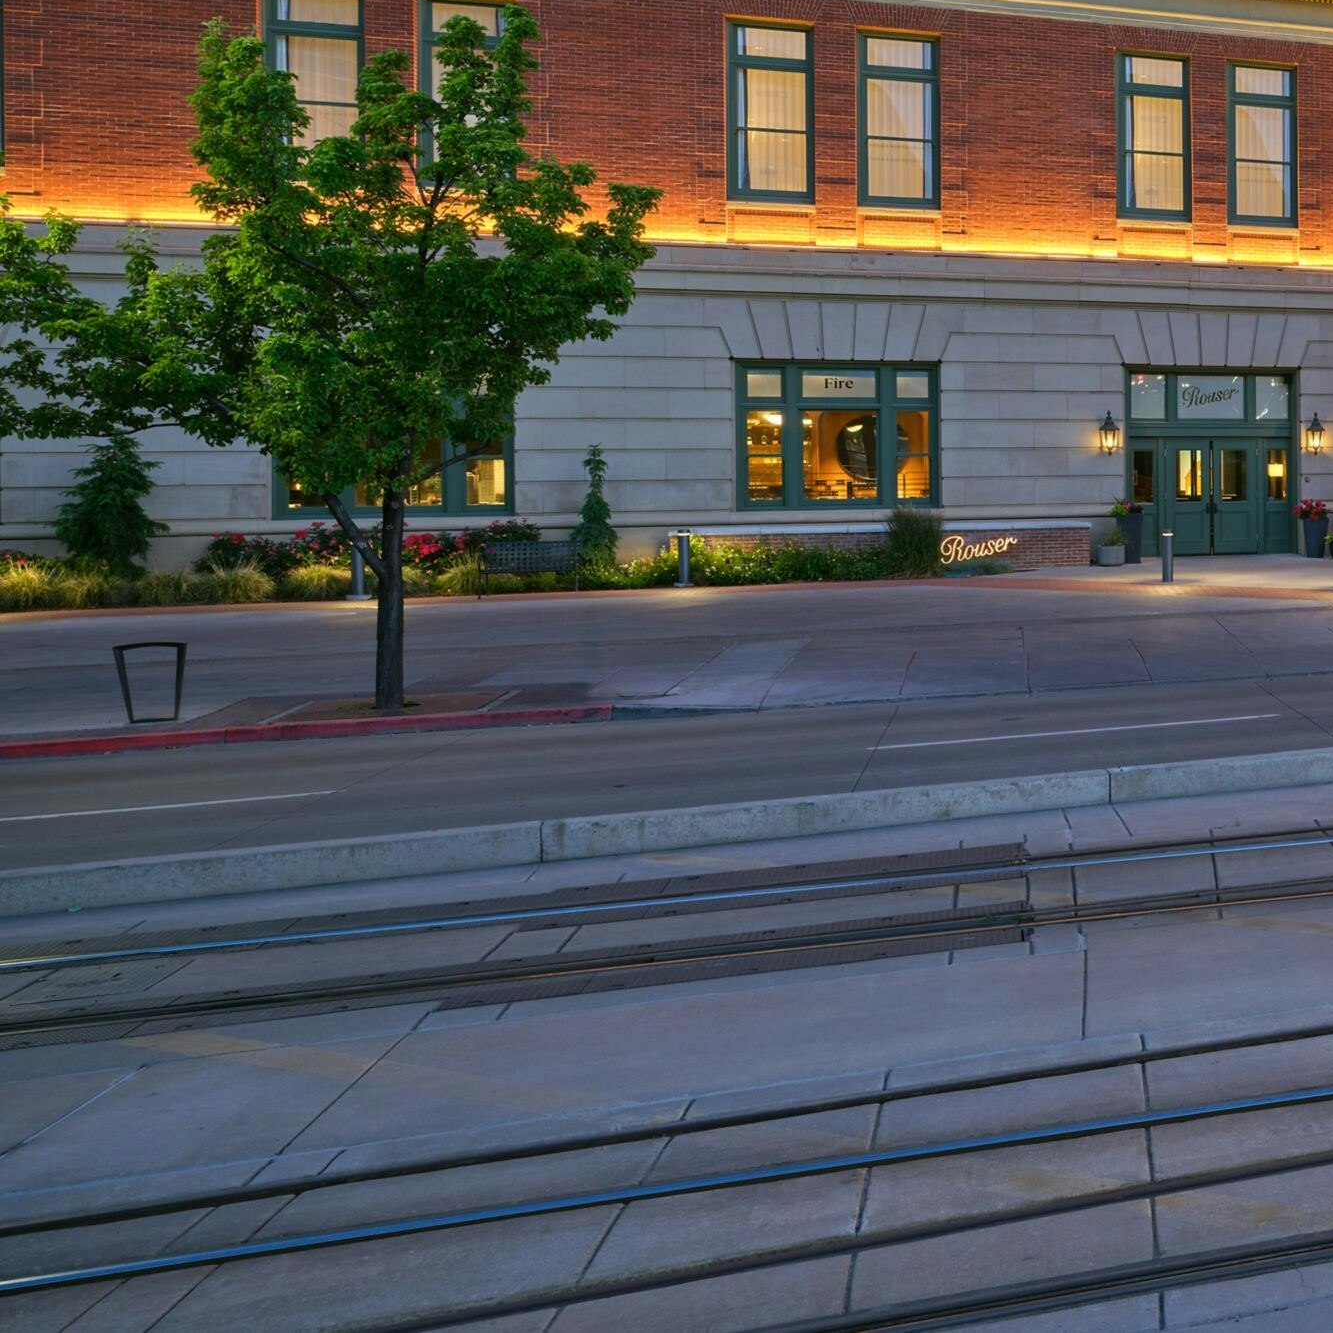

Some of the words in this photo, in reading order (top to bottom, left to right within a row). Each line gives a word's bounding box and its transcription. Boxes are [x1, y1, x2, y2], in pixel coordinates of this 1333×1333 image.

[824, 377, 854, 389] Fire
[1182, 386, 1240, 408] Rouser
[940, 535, 1018, 564] Rouser
